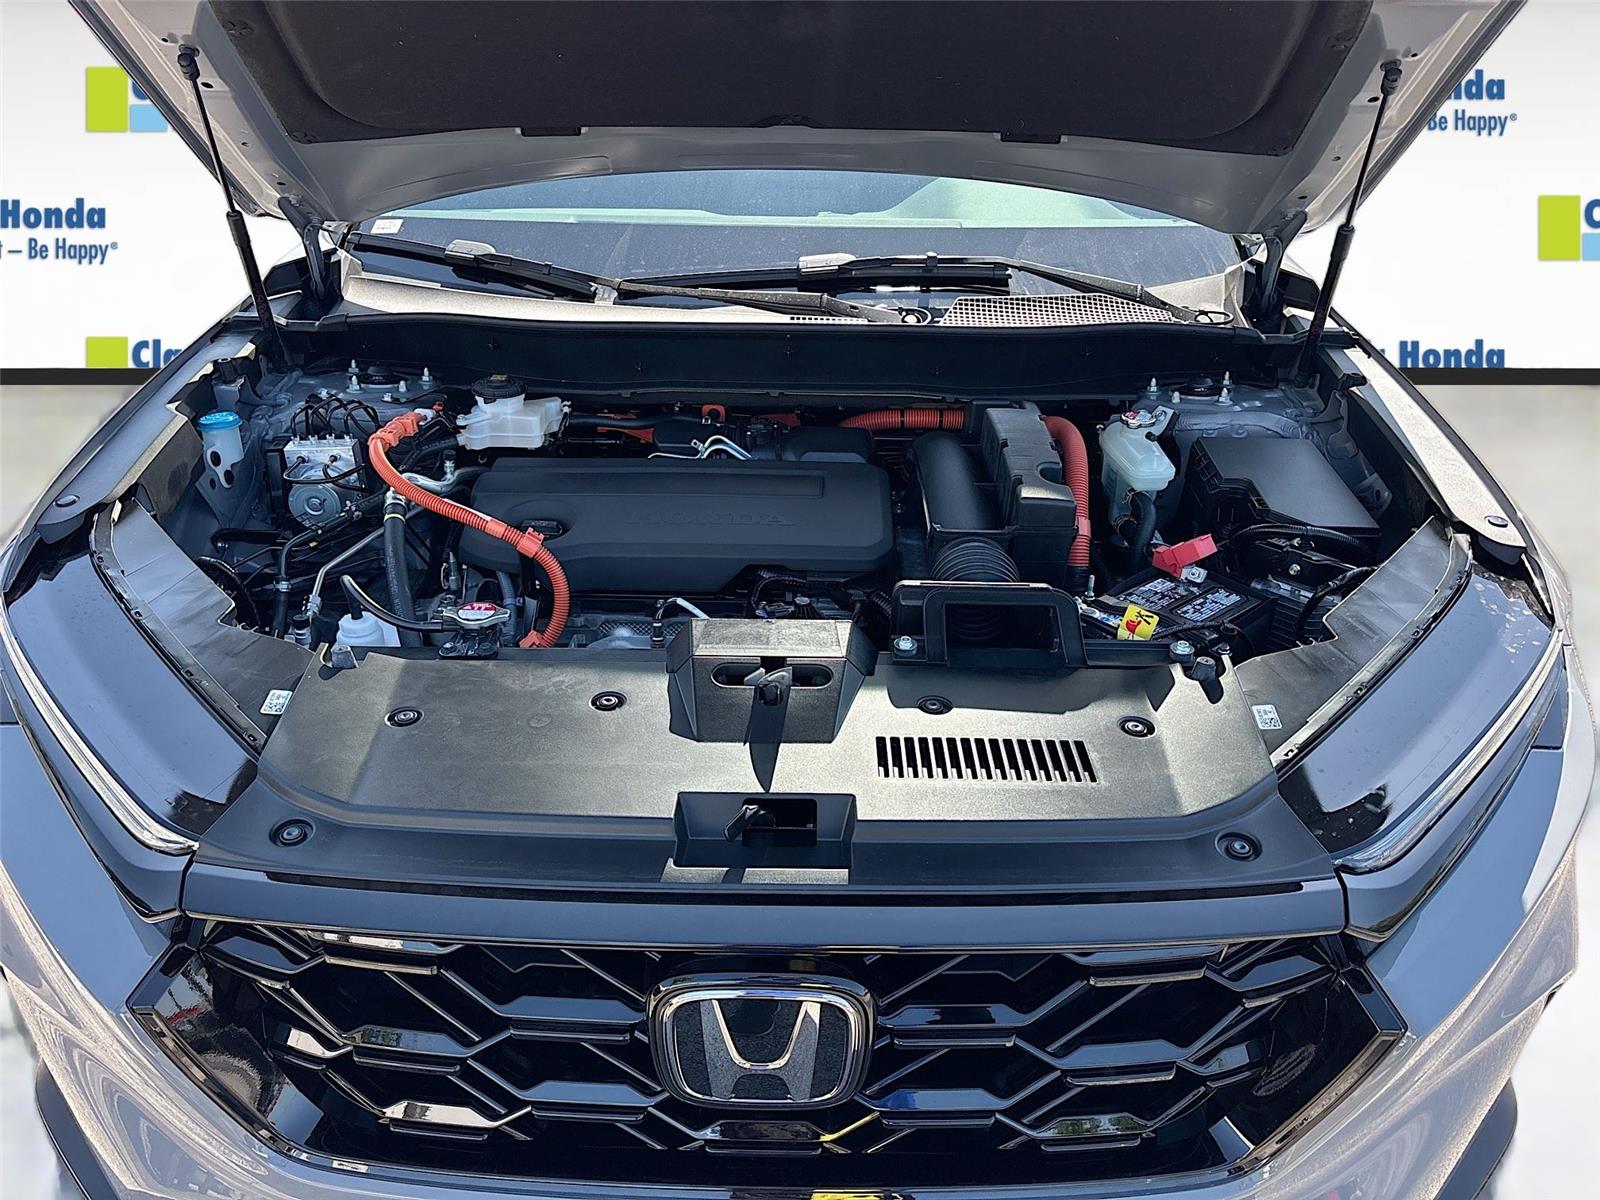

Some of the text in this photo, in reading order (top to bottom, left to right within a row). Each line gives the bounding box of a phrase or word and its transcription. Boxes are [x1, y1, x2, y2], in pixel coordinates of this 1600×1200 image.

[0, 198, 106, 229] Honda
[28, 237, 49, 260] Be
[1398, 338, 1505, 368] Honda
